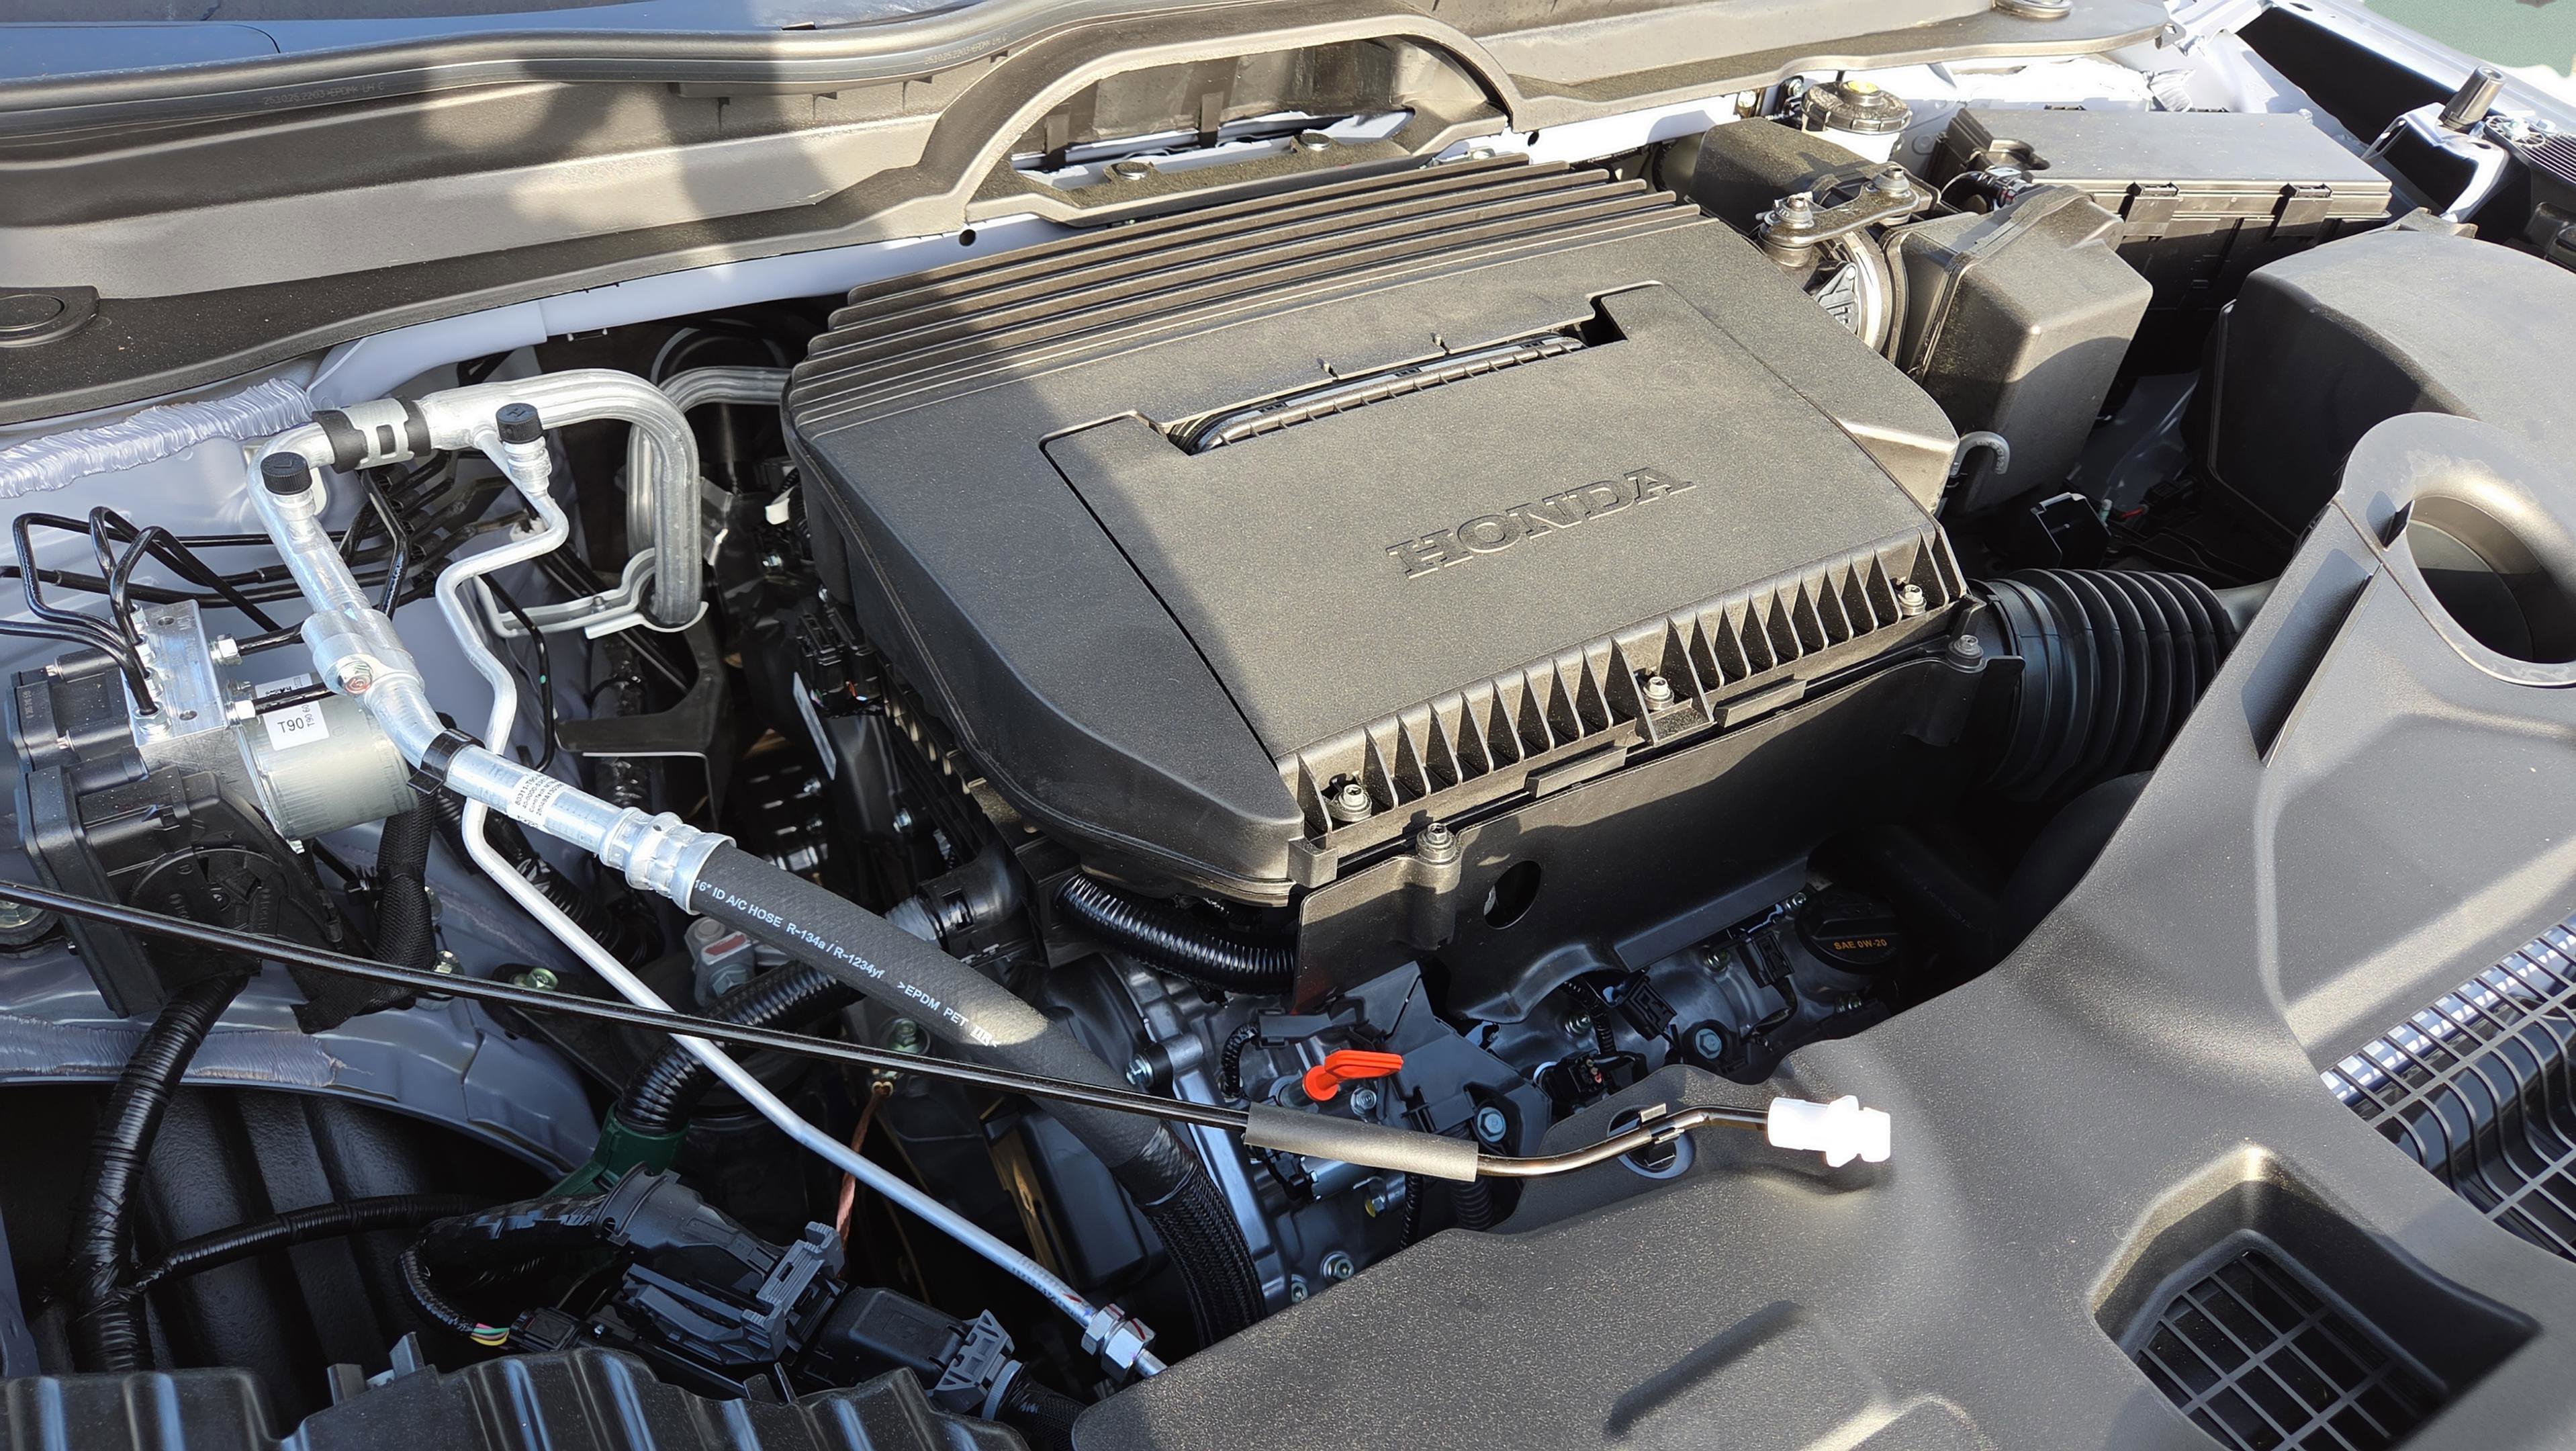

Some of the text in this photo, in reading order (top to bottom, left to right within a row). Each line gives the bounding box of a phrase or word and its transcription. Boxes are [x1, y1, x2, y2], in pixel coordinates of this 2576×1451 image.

[1385, 467, 1696, 579] HONDA
[277, 717, 304, 733] T90
[304, 713, 316, 728] T90
[1833, 938, 1888, 950] SAE 0W-20
[712, 887, 726, 901] ID
[725, 895, 747, 911] A/C
[747, 904, 784, 928] HOSE
[786, 922, 826, 950] R-134a
[833, 946, 886, 979] R-1234yf
[943, 1006, 970, 1027] PET
